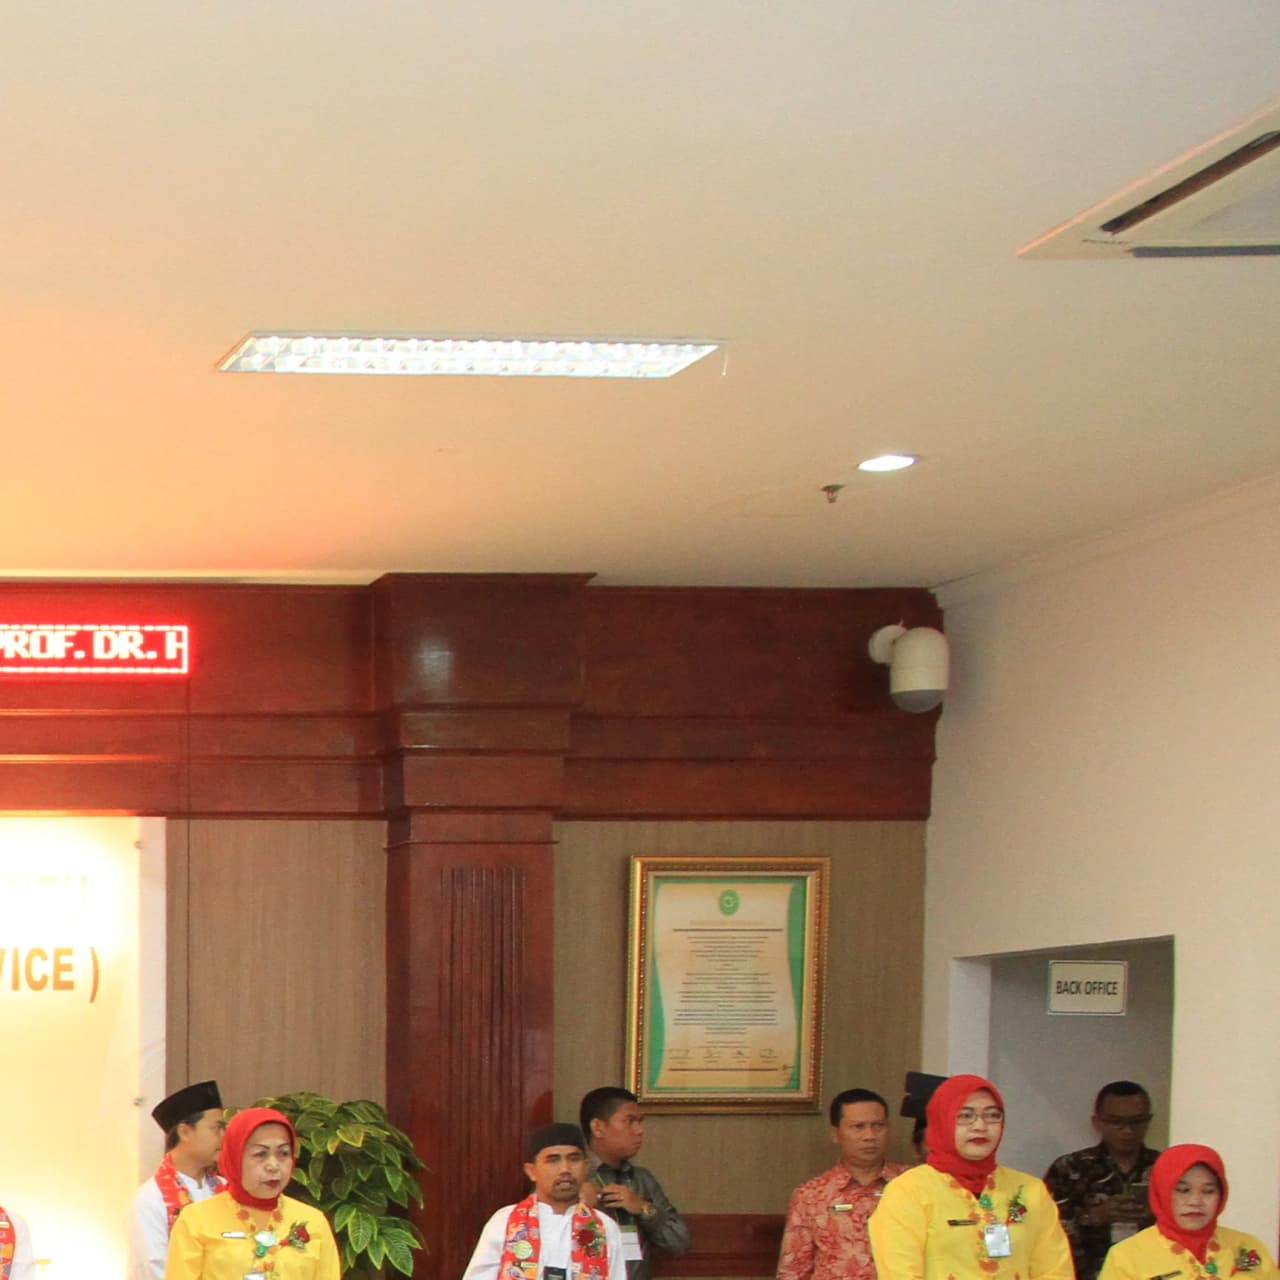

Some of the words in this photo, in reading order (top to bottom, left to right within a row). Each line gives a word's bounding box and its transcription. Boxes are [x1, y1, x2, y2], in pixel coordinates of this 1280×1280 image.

[94, 630, 157, 659] DR.
[1056, 981, 1081, 995] BACK
[1085, 981, 1118, 995] OFFICE
